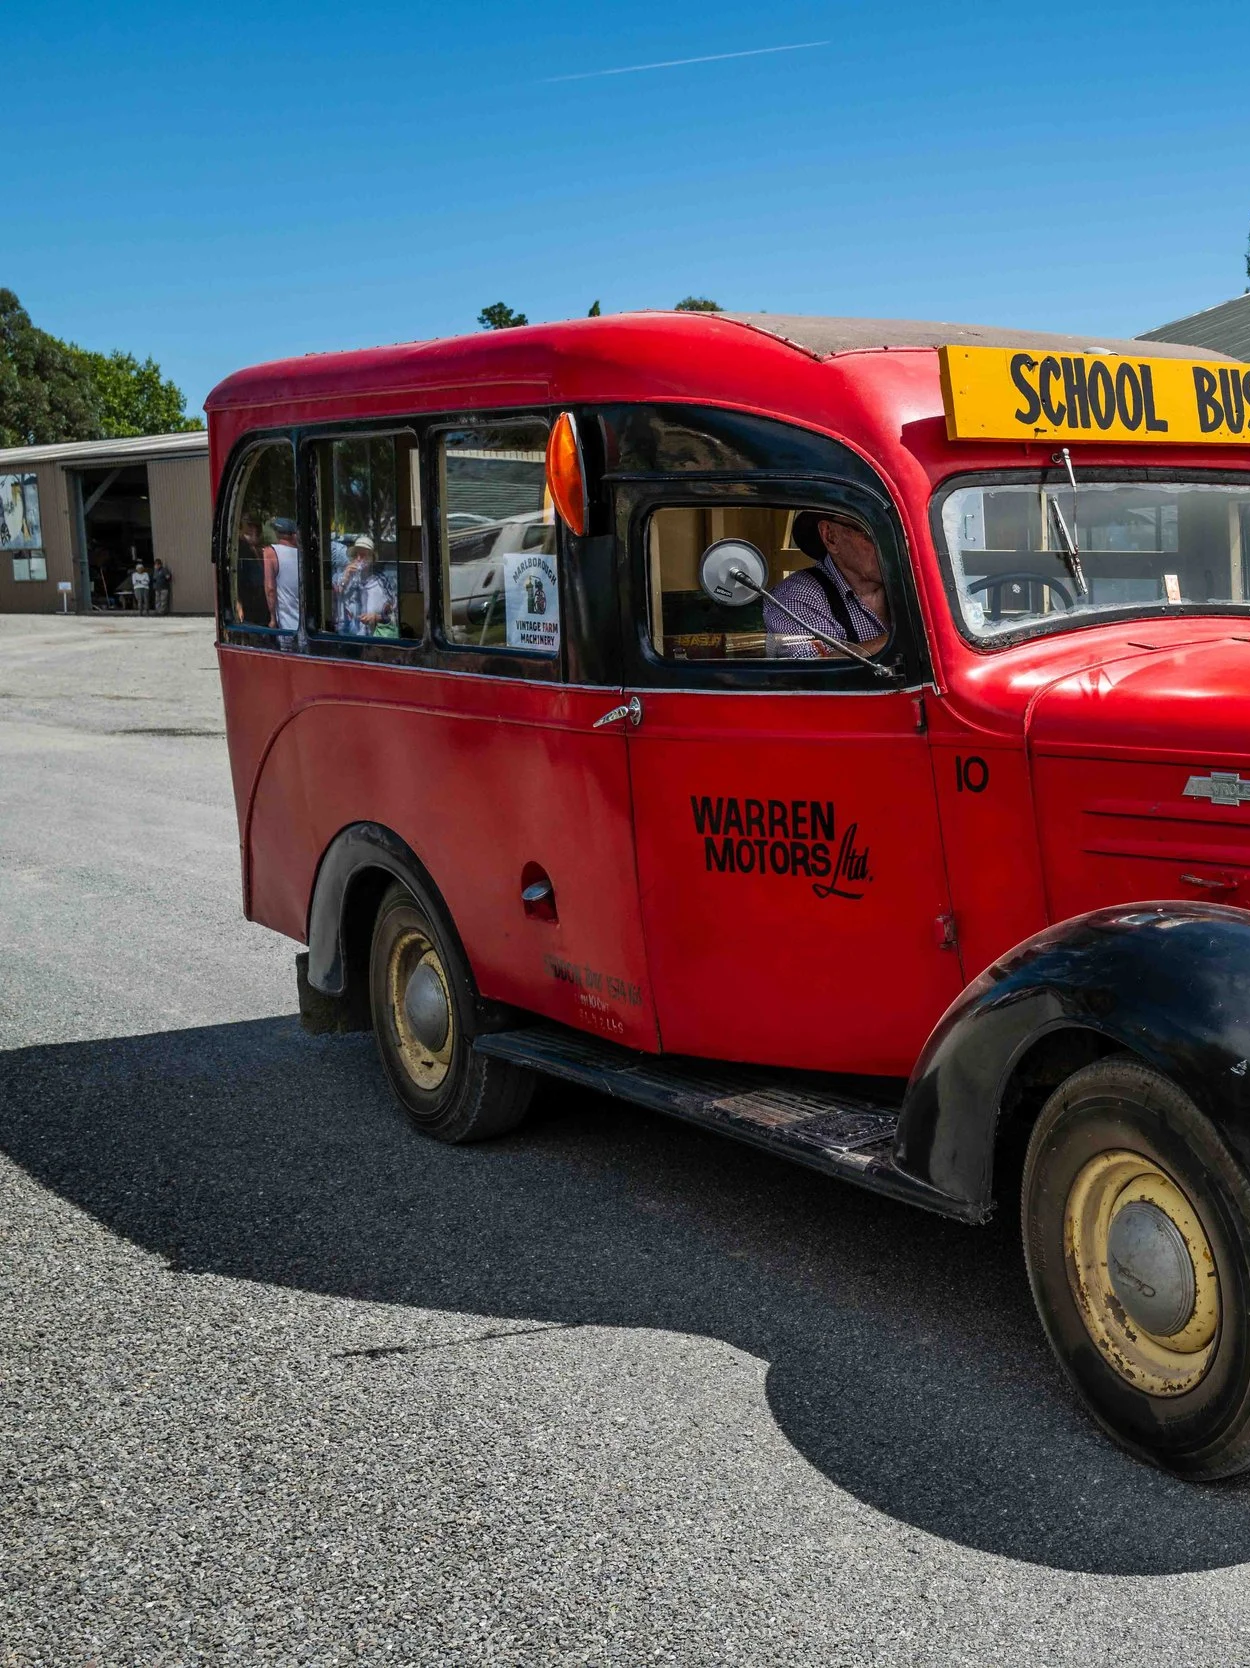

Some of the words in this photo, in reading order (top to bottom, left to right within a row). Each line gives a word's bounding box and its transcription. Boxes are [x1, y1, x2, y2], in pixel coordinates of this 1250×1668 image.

[1010, 353, 1168, 432] SCHOOL
[513, 557, 557, 586] MARLBOROUGH
[516, 620, 541, 632] VINTAGE
[542, 621, 559, 634] FARM
[520, 633, 556, 646] MACHINERY
[955, 755, 989, 793] 10
[690, 795, 835, 841] WARREN
[704, 837, 832, 878] MOTORS
